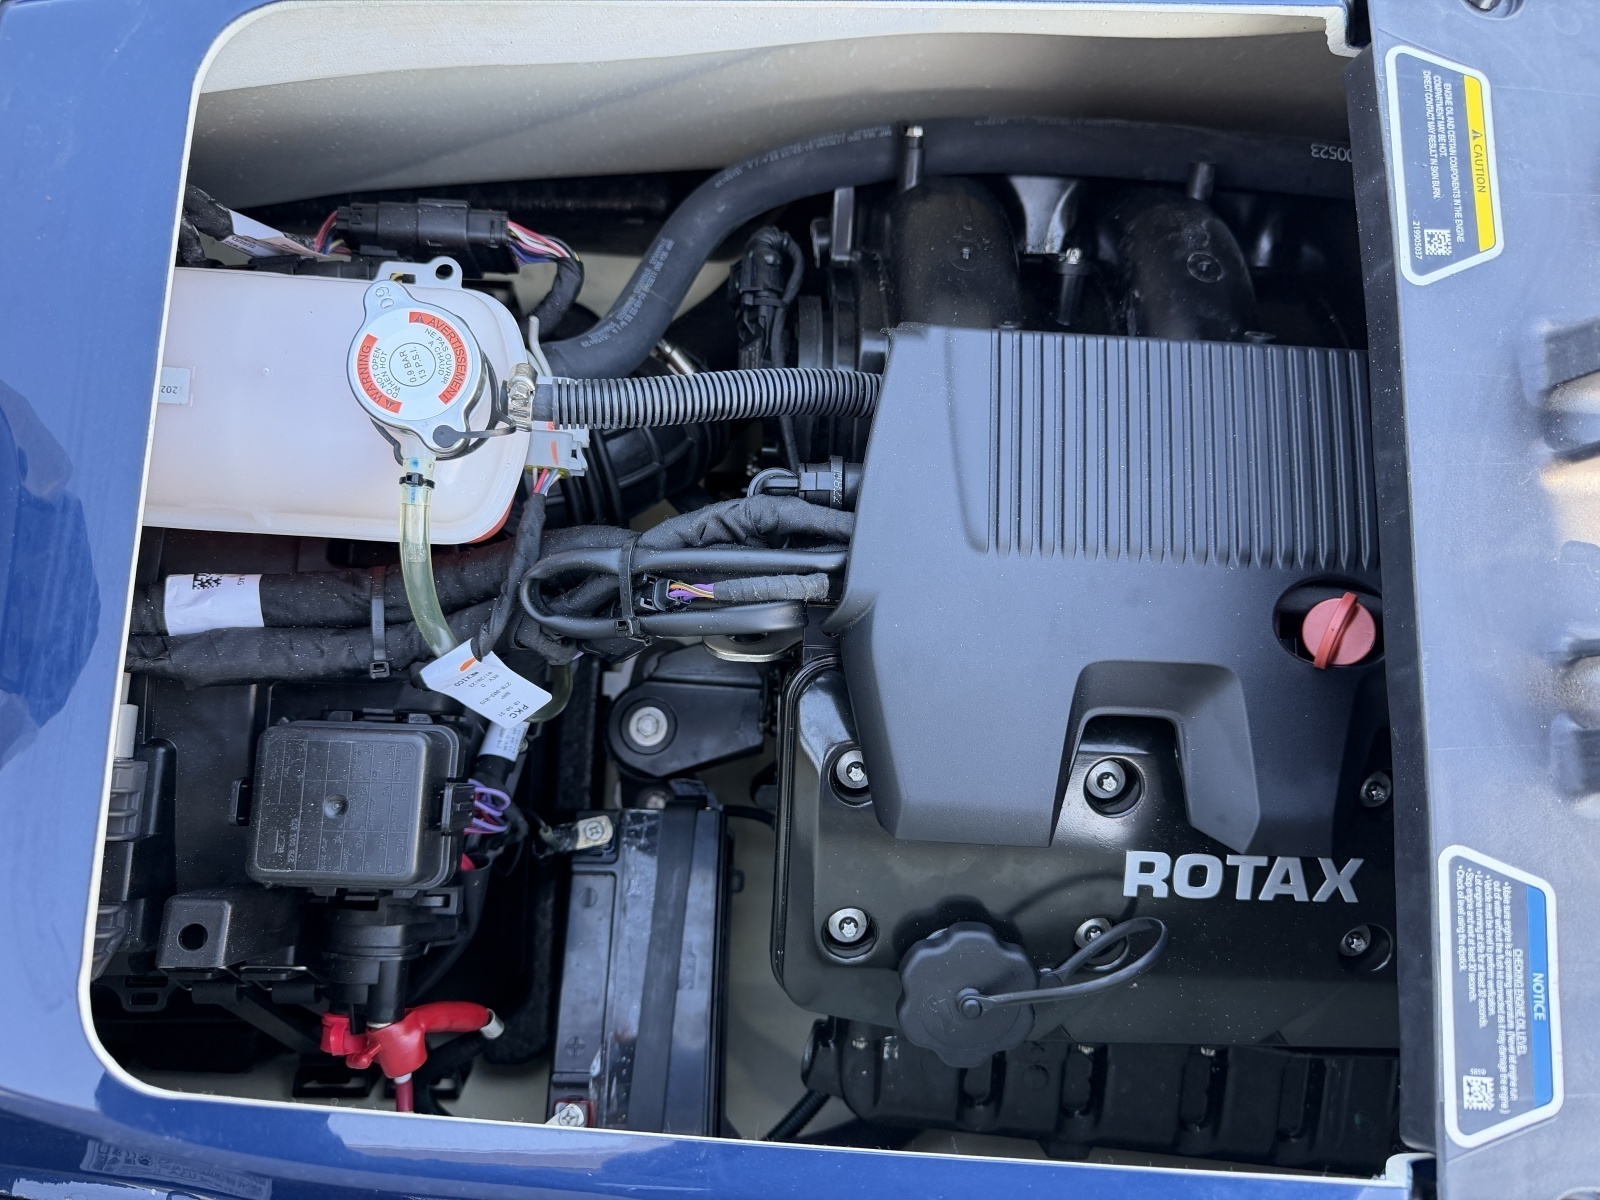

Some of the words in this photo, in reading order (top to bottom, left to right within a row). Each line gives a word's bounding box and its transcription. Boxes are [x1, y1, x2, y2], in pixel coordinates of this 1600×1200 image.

[1423, 70, 1432, 91] DIRECT
[1433, 75, 1445, 120] COMPARTMENT
[1444, 83, 1453, 106] ENGINE
[1424, 92, 1435, 120] CONTACT
[1445, 106, 1454, 116] OIL
[1427, 121, 1435, 134] MAY
[1437, 121, 1446, 134] MAY
[1446, 116, 1456, 129] AND
[1428, 134, 1438, 157] RESULT
[1438, 134, 1447, 142] BE
[1447, 130, 1457, 155] CERTAIN
[1430, 166, 1439, 180] SKIN
[1449, 156, 1461, 198] COMPONENTS
[1474, 144, 1487, 193] CAUTION
[1454, 206, 1463, 218] THE
[1455, 219, 1465, 243] ENGINE
[1412, 221, 1422, 259] 219905037
[424, 328, 437, 338] NE
[437, 336, 449, 352] PAS
[371, 346, 381, 370] OPEN
[379, 351, 388, 369] HOT
[399, 350, 412, 369] BAR
[427, 317, 467, 403] AVERTISSEMENT
[434, 345, 445, 375] CHAUD
[361, 345, 380, 403] WARNING
[406, 370, 417, 383] 0.9
[418, 369, 427, 380] 13
[440, 353, 452, 385] OUVRIR
[159, 385, 178, 394] 202
[373, 373, 388, 389] NOT
[380, 370, 401, 394] WHEN
[386, 388, 399, 399] DO
[454, 672, 479, 687] MEXICO
[509, 704, 529, 719] PKC
[1122, 850, 1365, 903] ROTAX
[1456, 870, 1465, 890] Check
[1465, 872, 1474, 887] Stop
[1475, 875, 1483, 886] Let
[1484, 879, 1493, 902] Vehicle
[1494, 881, 1502, 892] out
[1503, 886, 1511, 904] Make
[1464, 888, 1473, 910] engine
[1474, 886, 1484, 908] engine
[1458, 900, 1466, 914] level
[1485, 903, 1493, 919] must
[1495, 900, 1503, 918] water
[1456, 916, 1466, 933] using
[1467, 911, 1475, 924] and
[1475, 909, 1484, 933] running
[1486, 920, 1494, 929] be
[1467, 925, 1475, 938] wait
[1486, 930, 1494, 945] level
[1495, 919, 1504, 942] without
[1502, 920, 1512, 942] engine
[1458, 934, 1467, 945] the
[1477, 942, 1485, 953] idle
[1468, 946, 1476, 962] least
[1496, 943, 1504, 954] the
[1477, 954, 1485, 963] for
[1485, 953, 1495, 979] perform
[1496, 955, 1505, 970] flush
[1468, 963, 1477, 972] 30
[1496, 971, 1505, 979] kit
[1504, 957, 1514, 988] operating
[1514, 949, 1524, 988] CHECKING
[1478, 971, 1486, 988] least
[1478, 989, 1487, 998] 30
[1497, 980, 1505, 1014] connected
[1532, 973, 1547, 1020] NOTICE
[1515, 989, 1526, 1018] ENGINE
[1517, 1018, 1526, 1030] OIL
[1497, 1030, 1506, 1044] may
[1507, 1031, 1516, 1054] (Never
[1517, 1031, 1527, 1055] LEVEL
[1498, 1046, 1508, 1072] damage
[1509, 1055, 1517, 1064] let
[1500, 1073, 1509, 1085] the
[1508, 1064, 1518, 1087] engine
[1499, 1086, 1510, 1114] engine.)
[1510, 1088, 1518, 1100] run
